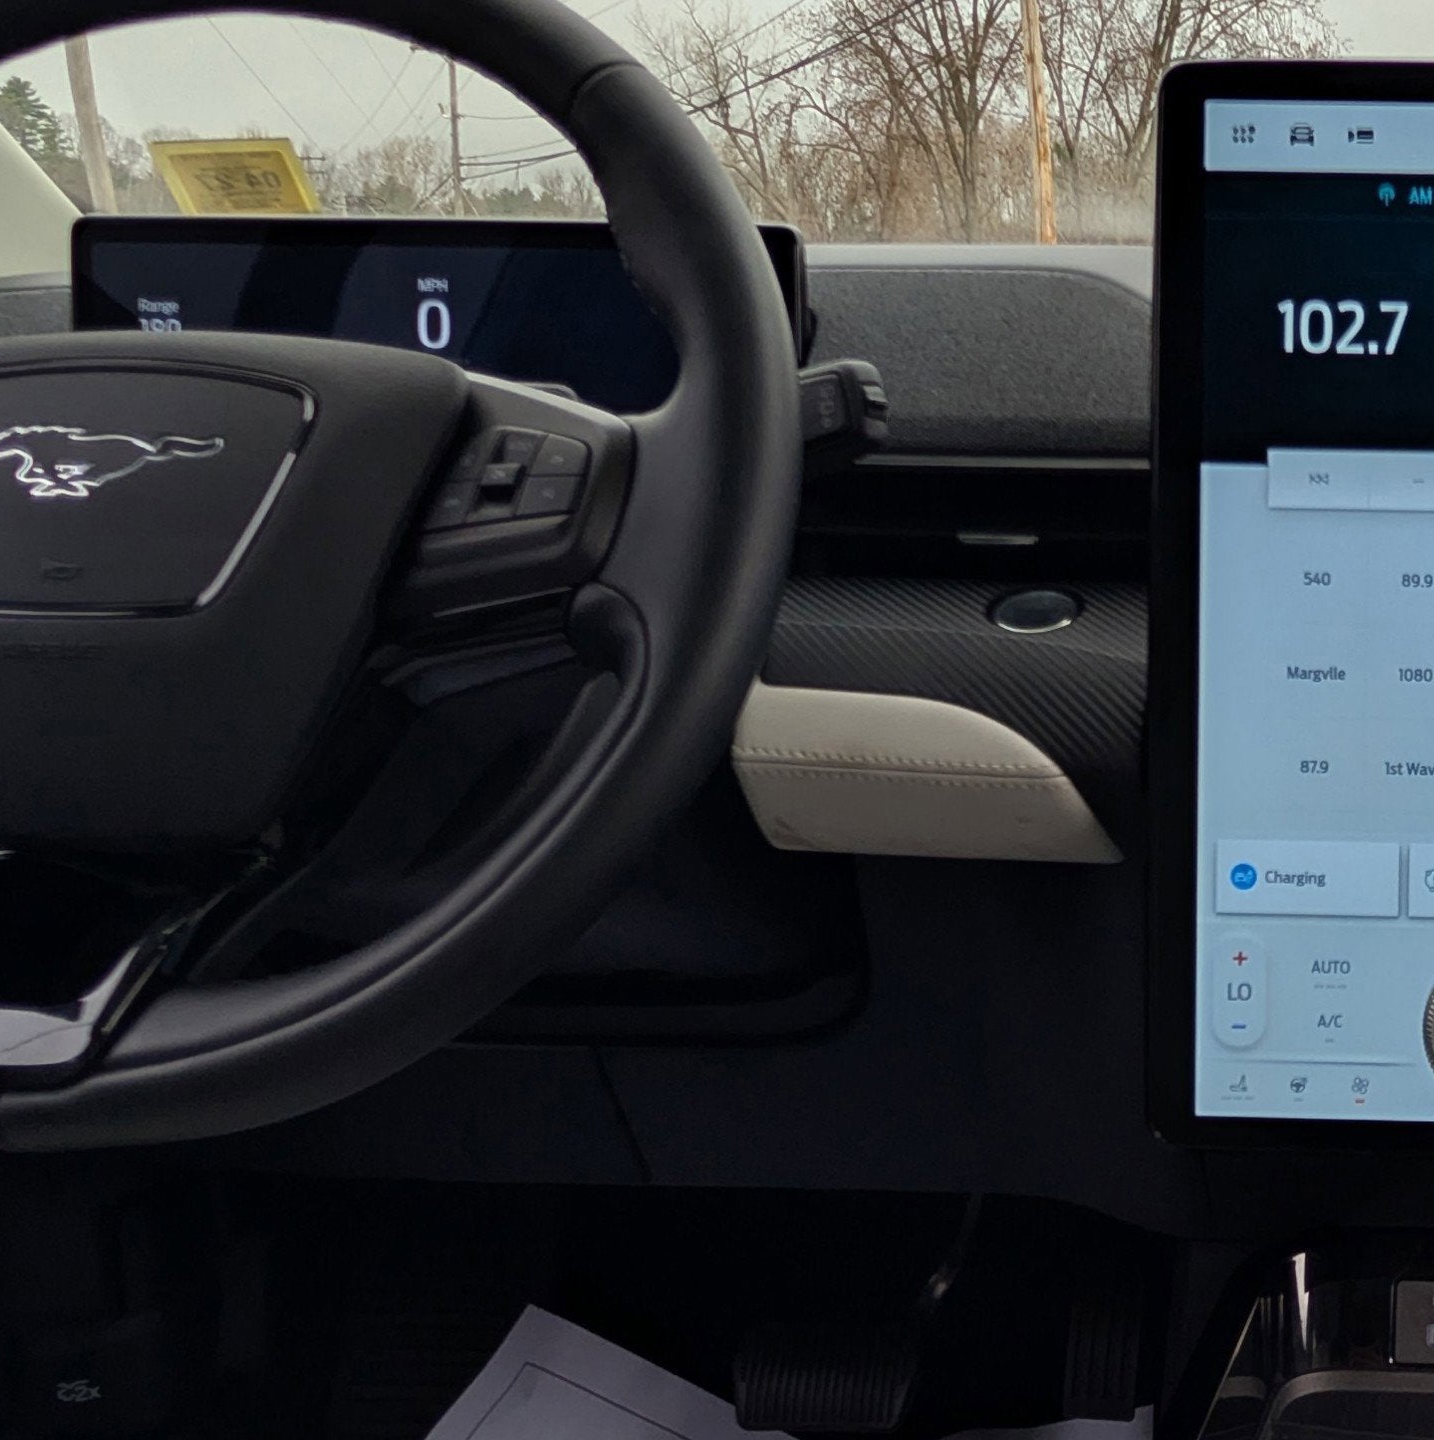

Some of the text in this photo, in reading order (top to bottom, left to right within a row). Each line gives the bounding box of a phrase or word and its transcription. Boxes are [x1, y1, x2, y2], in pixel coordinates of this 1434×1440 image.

[1408, 188, 1433, 206] AM
[137, 297, 180, 316] Range
[417, 298, 451, 349] 0
[1277, 299, 1409, 357] 102.7
[1303, 571, 1331, 587] 540
[1401, 574, 1434, 588] 89.9
[1398, 668, 1434, 682] 1080
[1300, 760, 1329, 774] 87.9
[1385, 762, 1403, 776] 1st
[1264, 870, 1326, 888] Charging
[1311, 960, 1351, 975] AUTO
[1227, 982, 1252, 1001] LO
[1317, 1014, 1343, 1029] A/C
